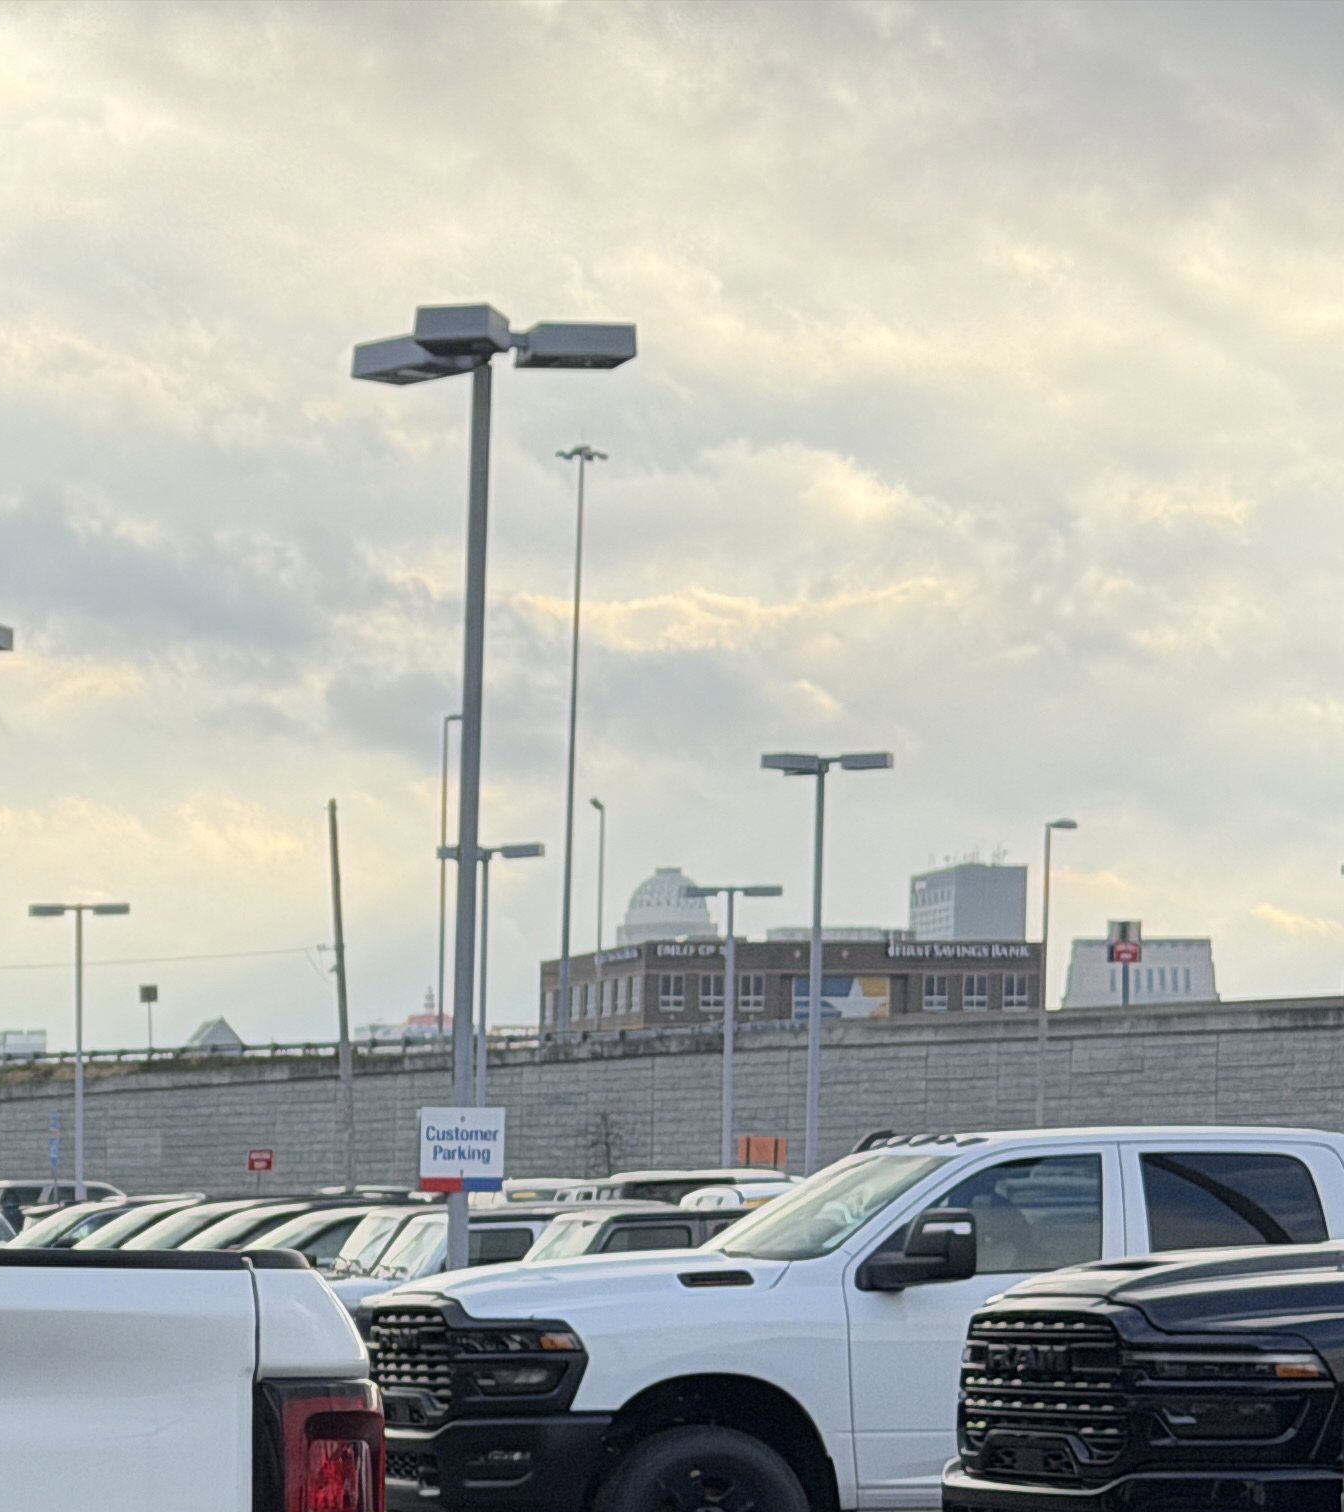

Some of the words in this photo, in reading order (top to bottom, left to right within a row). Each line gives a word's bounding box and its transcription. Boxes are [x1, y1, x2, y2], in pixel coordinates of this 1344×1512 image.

[991, 944, 1031, 958] BANK
[425, 1125, 499, 1142] Customer
[432, 1145, 491, 1165] Parking
